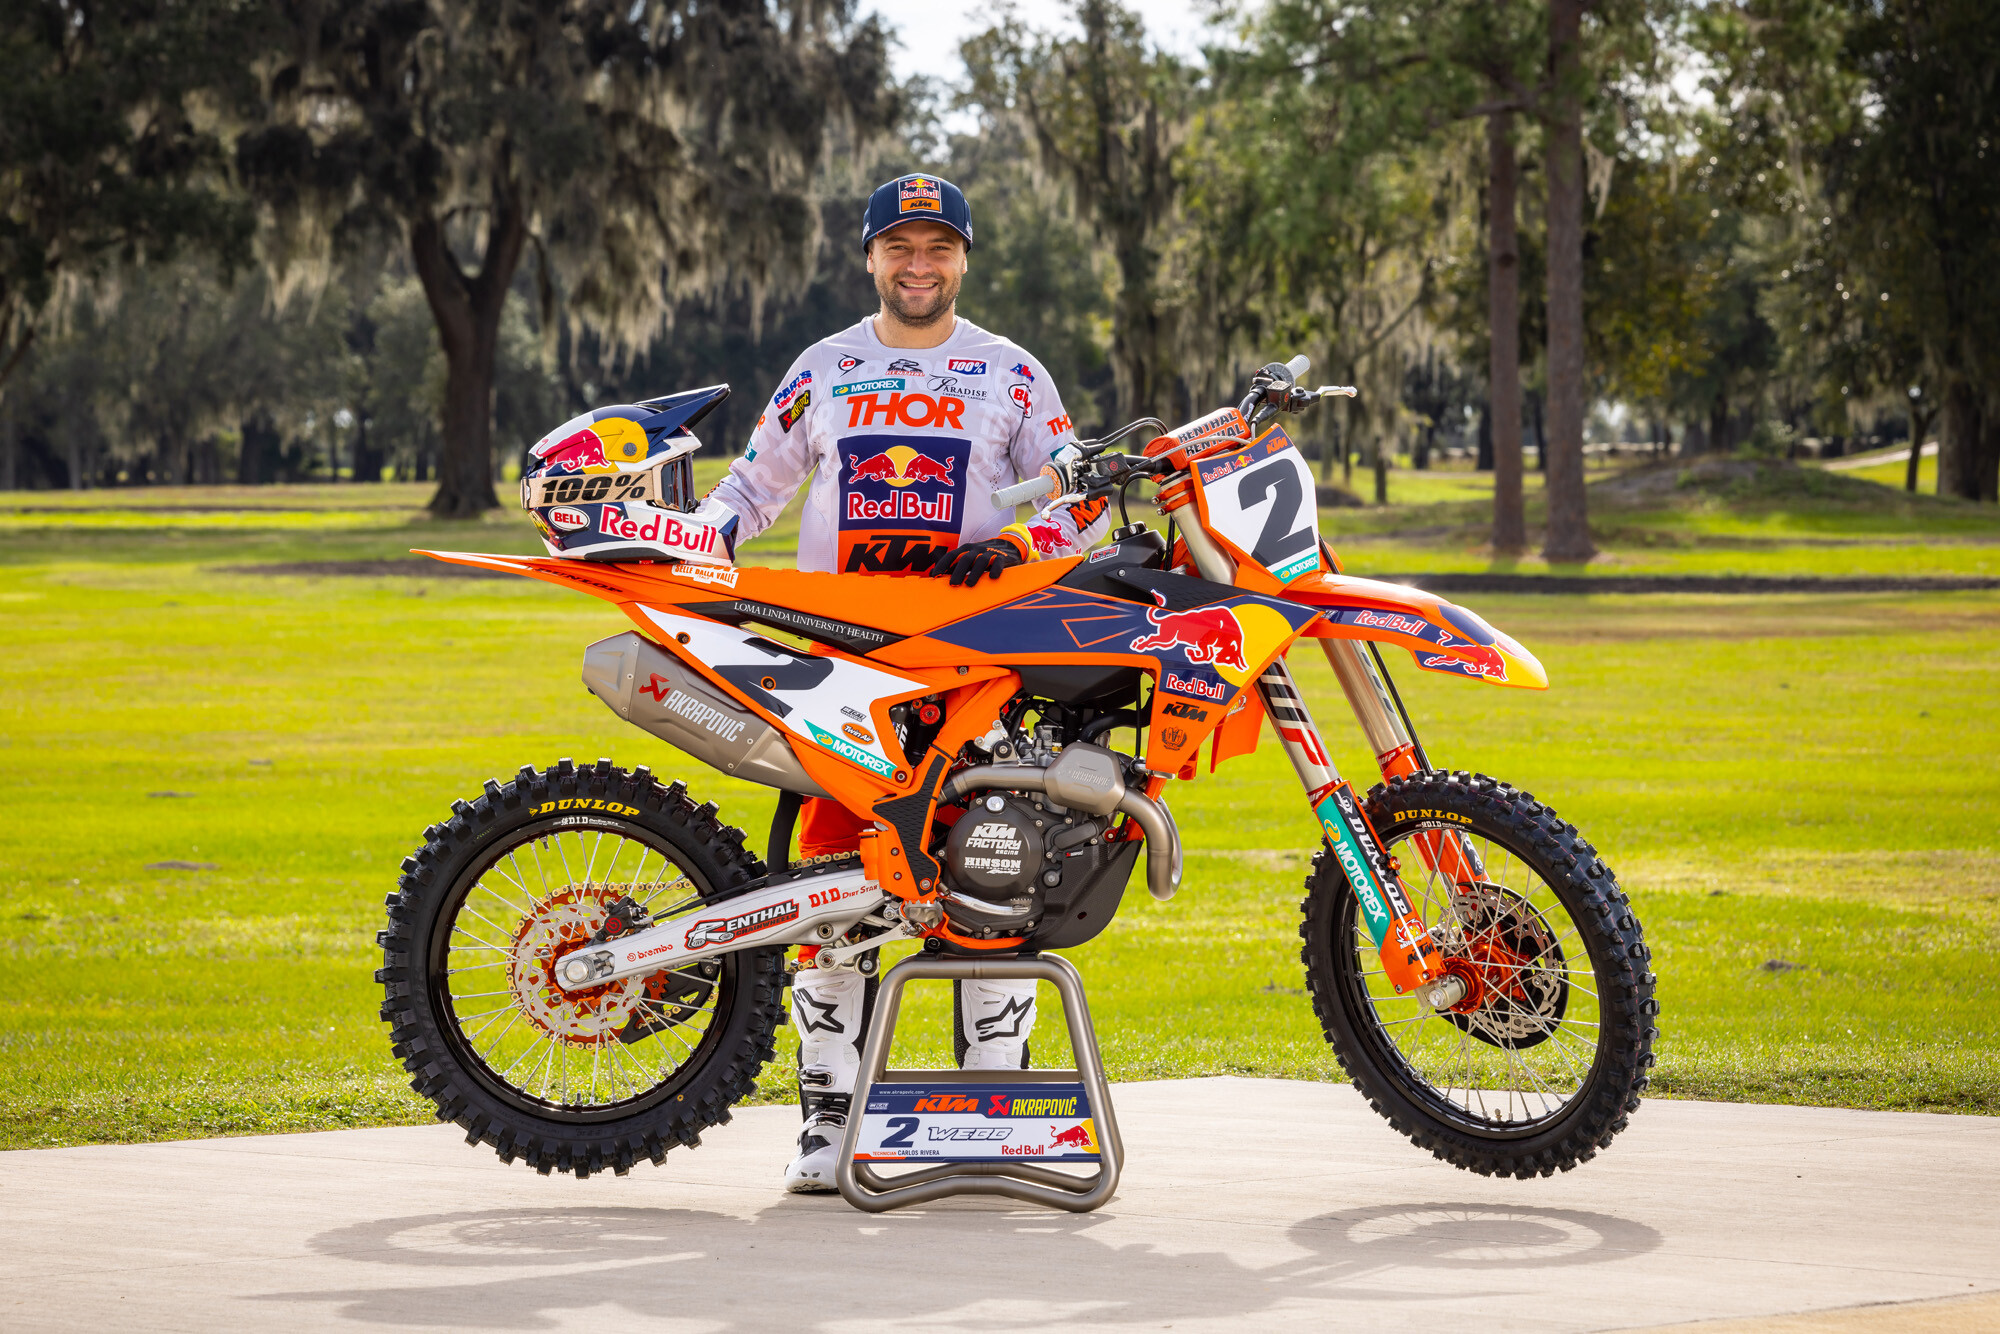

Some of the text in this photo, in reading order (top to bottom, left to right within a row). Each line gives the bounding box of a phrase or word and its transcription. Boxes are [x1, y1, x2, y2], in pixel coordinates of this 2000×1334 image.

[901, 188, 939, 199] Red Bull
[951, 361, 984, 373] 100%
[851, 380, 899, 392] MOTOREX
[927, 374, 988, 397] PARADISE
[846, 392, 965, 430] THOR
[1178, 412, 1238, 443] RENTHAL
[1266, 436, 1288, 454] KTM
[1202, 461, 1233, 483] Red Bull
[542, 474, 646, 503] 100%
[848, 490, 953, 522] Red Bull
[1238, 458, 1316, 567] 2
[554, 511, 584, 525] BELL
[601, 506, 717, 554] Red Bull
[845, 535, 948, 573] KTM
[675, 564, 735, 584] SELLE DALLA VALLE
[1289, 556, 1318, 575] MOTOREX
[734, 602, 884, 643] LOMA LINDA UNIVERSITY HEALTH
[1353, 609, 1394, 627] Red
[1386, 613, 1428, 636] Bull
[1166, 673, 1225, 700] Red Bull
[663, 689, 746, 742] AKRAPOVIČ
[1162, 701, 1208, 722] KTM
[843, 725, 873, 743] Twin Air
[832, 739, 888, 775] MOTOREX
[539, 798, 640, 817] DUNLOP
[1393, 809, 1473, 824] DUNLOP
[972, 823, 1017, 839] KTM
[965, 837, 1021, 850] FACTORY
[964, 856, 1021, 868] HINSON
[1335, 841, 1386, 923] MOTOREX
[687, 901, 797, 948] RENTHAL
[736, 912, 797, 936] CHAINWHEELS
[637, 944, 673, 959] brembo
[1408, 942, 1435, 965] KTM
[913, 1094, 979, 1112] KTM
[1011, 1096, 1077, 1116] AKRAPOVIČ
[880, 1116, 920, 1148] 2
[928, 1127, 1013, 1141] WEBB
[1001, 1144, 1044, 1155] Red Bull
